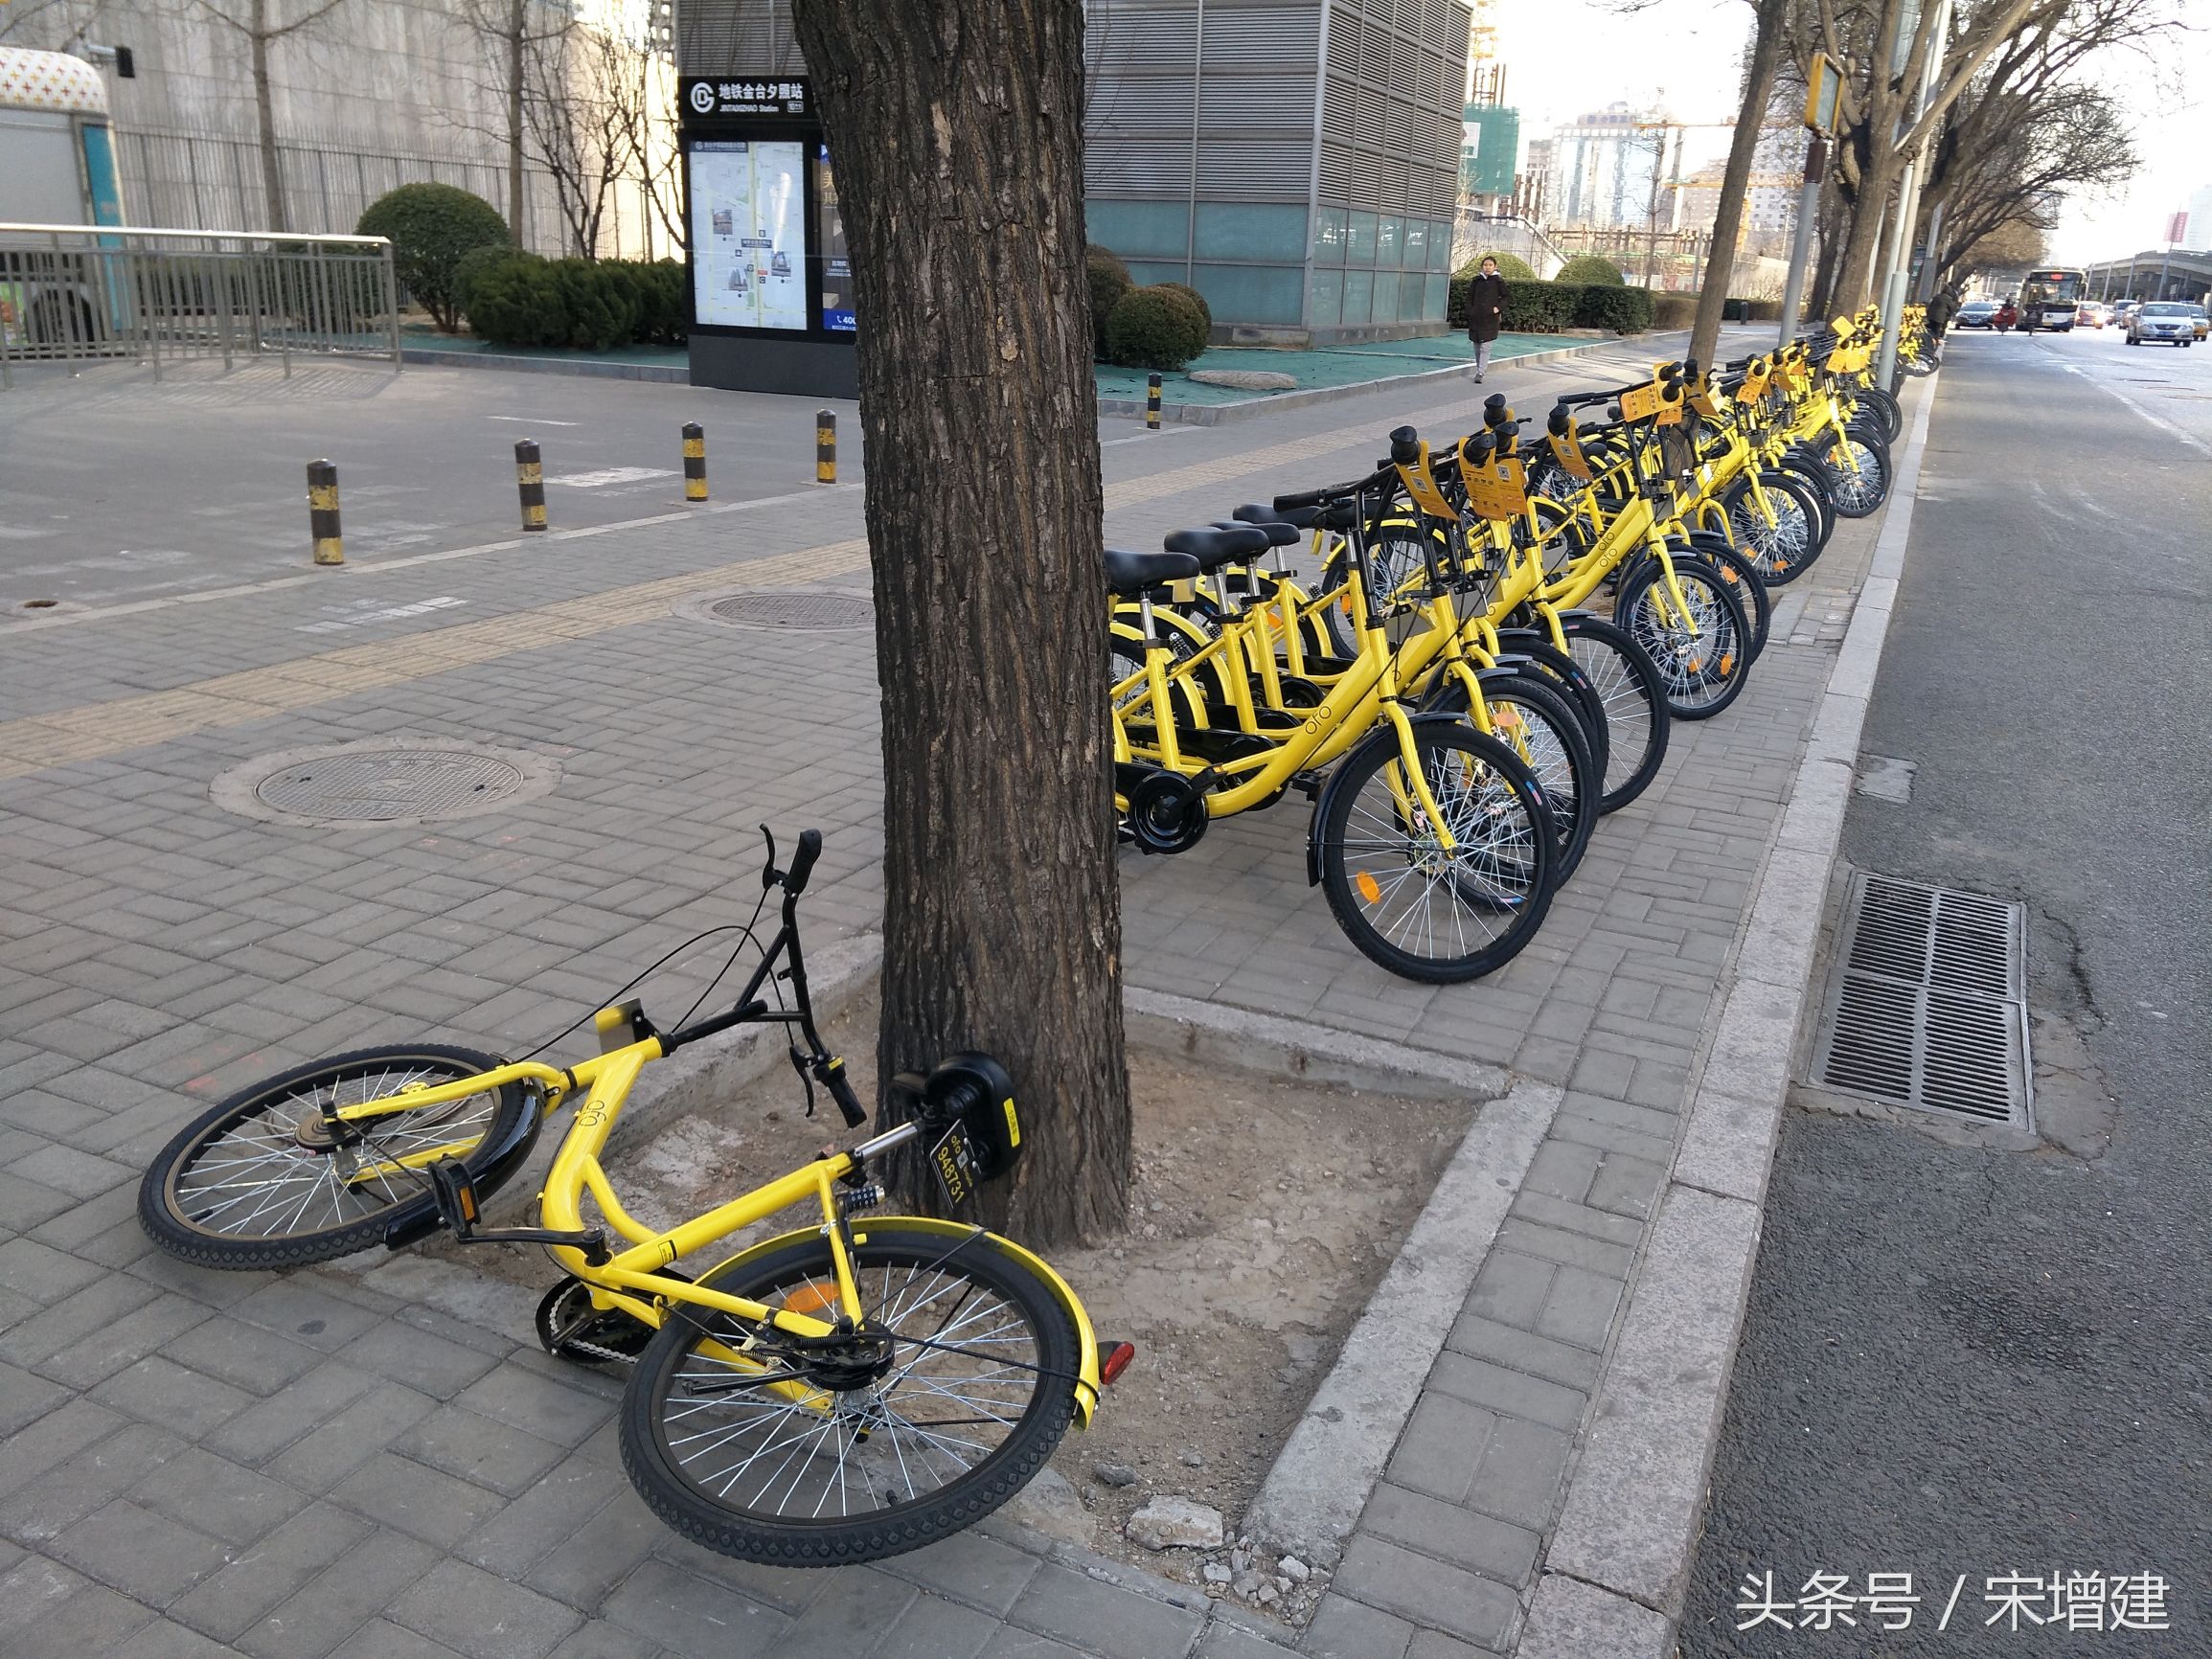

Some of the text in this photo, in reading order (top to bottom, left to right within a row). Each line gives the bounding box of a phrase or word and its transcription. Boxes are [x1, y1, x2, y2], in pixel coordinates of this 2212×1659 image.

[718, 82, 804, 100] 地铁金台夕照站
[1598, 532, 1615, 552] ofo
[1600, 548, 1618, 568] ofo
[1305, 705, 1332, 735] ofo
[579, 1100, 607, 1127] ofo
[950, 1135, 962, 1154] ofo
[937, 1146, 965, 1204] 948731
